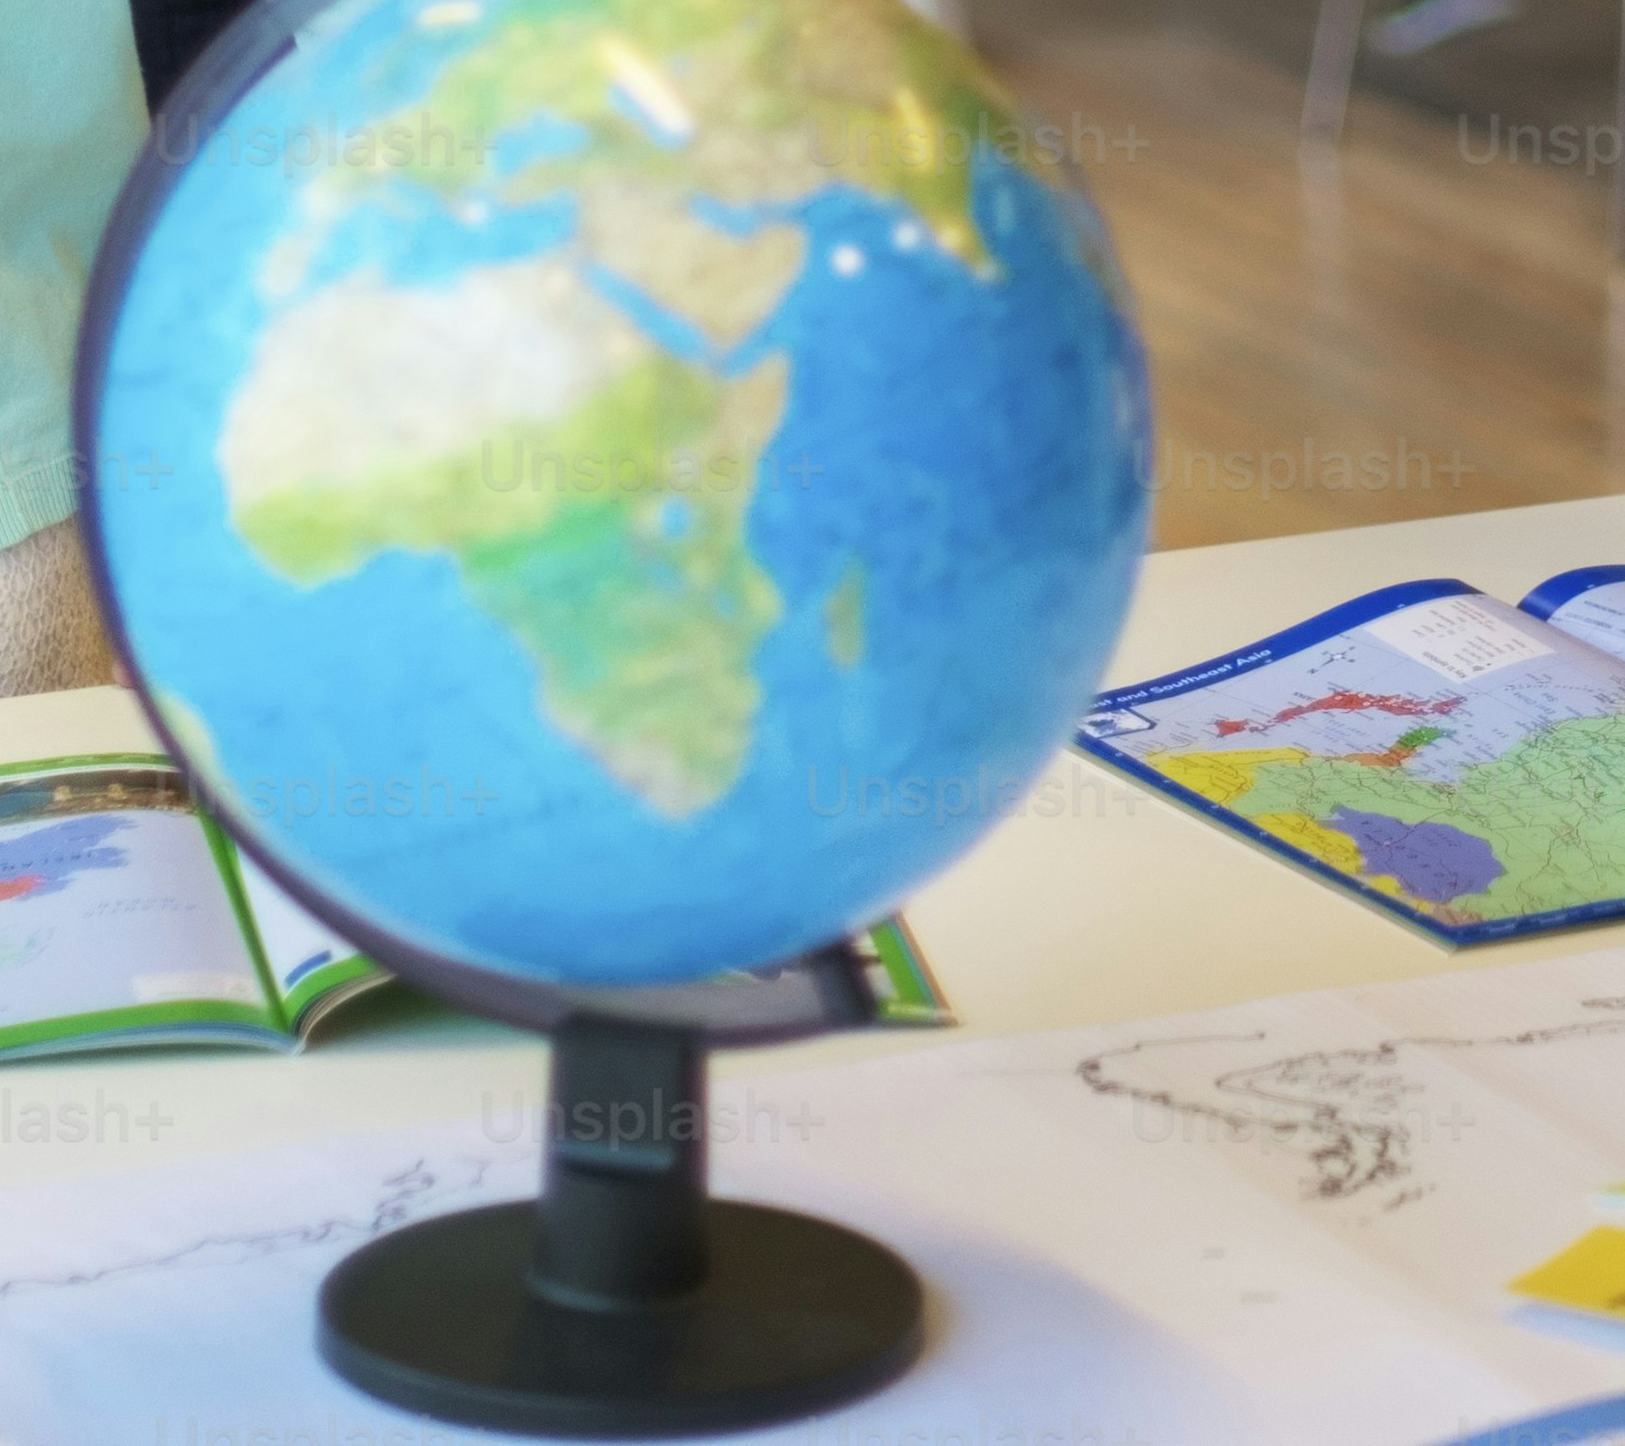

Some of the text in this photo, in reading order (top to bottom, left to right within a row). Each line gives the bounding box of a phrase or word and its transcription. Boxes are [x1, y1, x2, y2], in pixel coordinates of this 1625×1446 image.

[1116, 689, 1149, 703] and
[1149, 663, 1234, 695] Southeast
[1235, 648, 1273, 668] Asia
